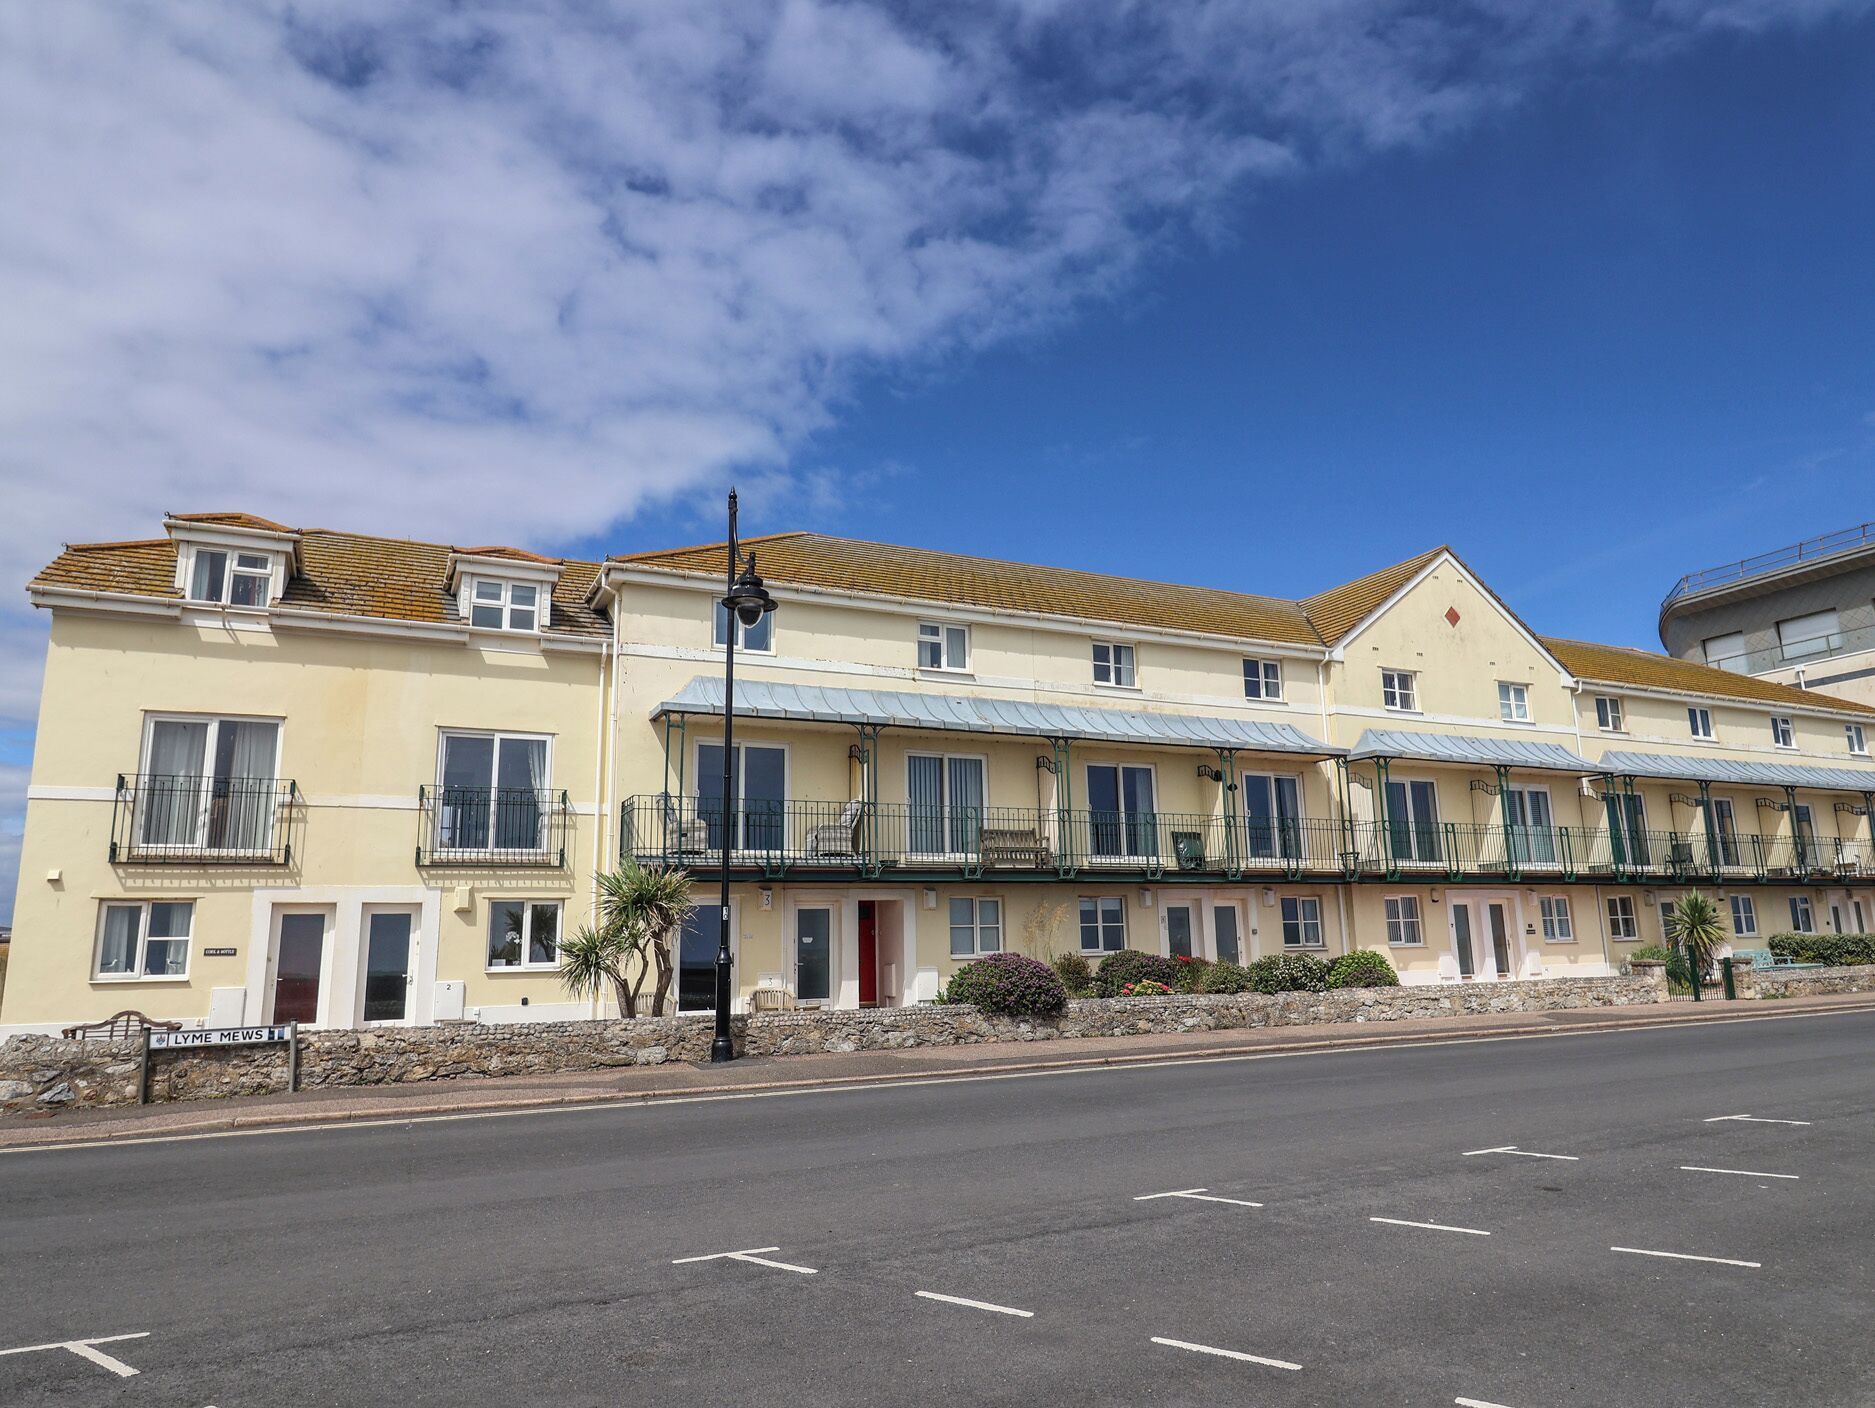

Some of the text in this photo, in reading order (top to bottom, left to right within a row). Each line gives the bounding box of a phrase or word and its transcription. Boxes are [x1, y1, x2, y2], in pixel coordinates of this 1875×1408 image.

[764, 895, 770, 905] 3
[175, 1030, 263, 1045] LYME MEWS
